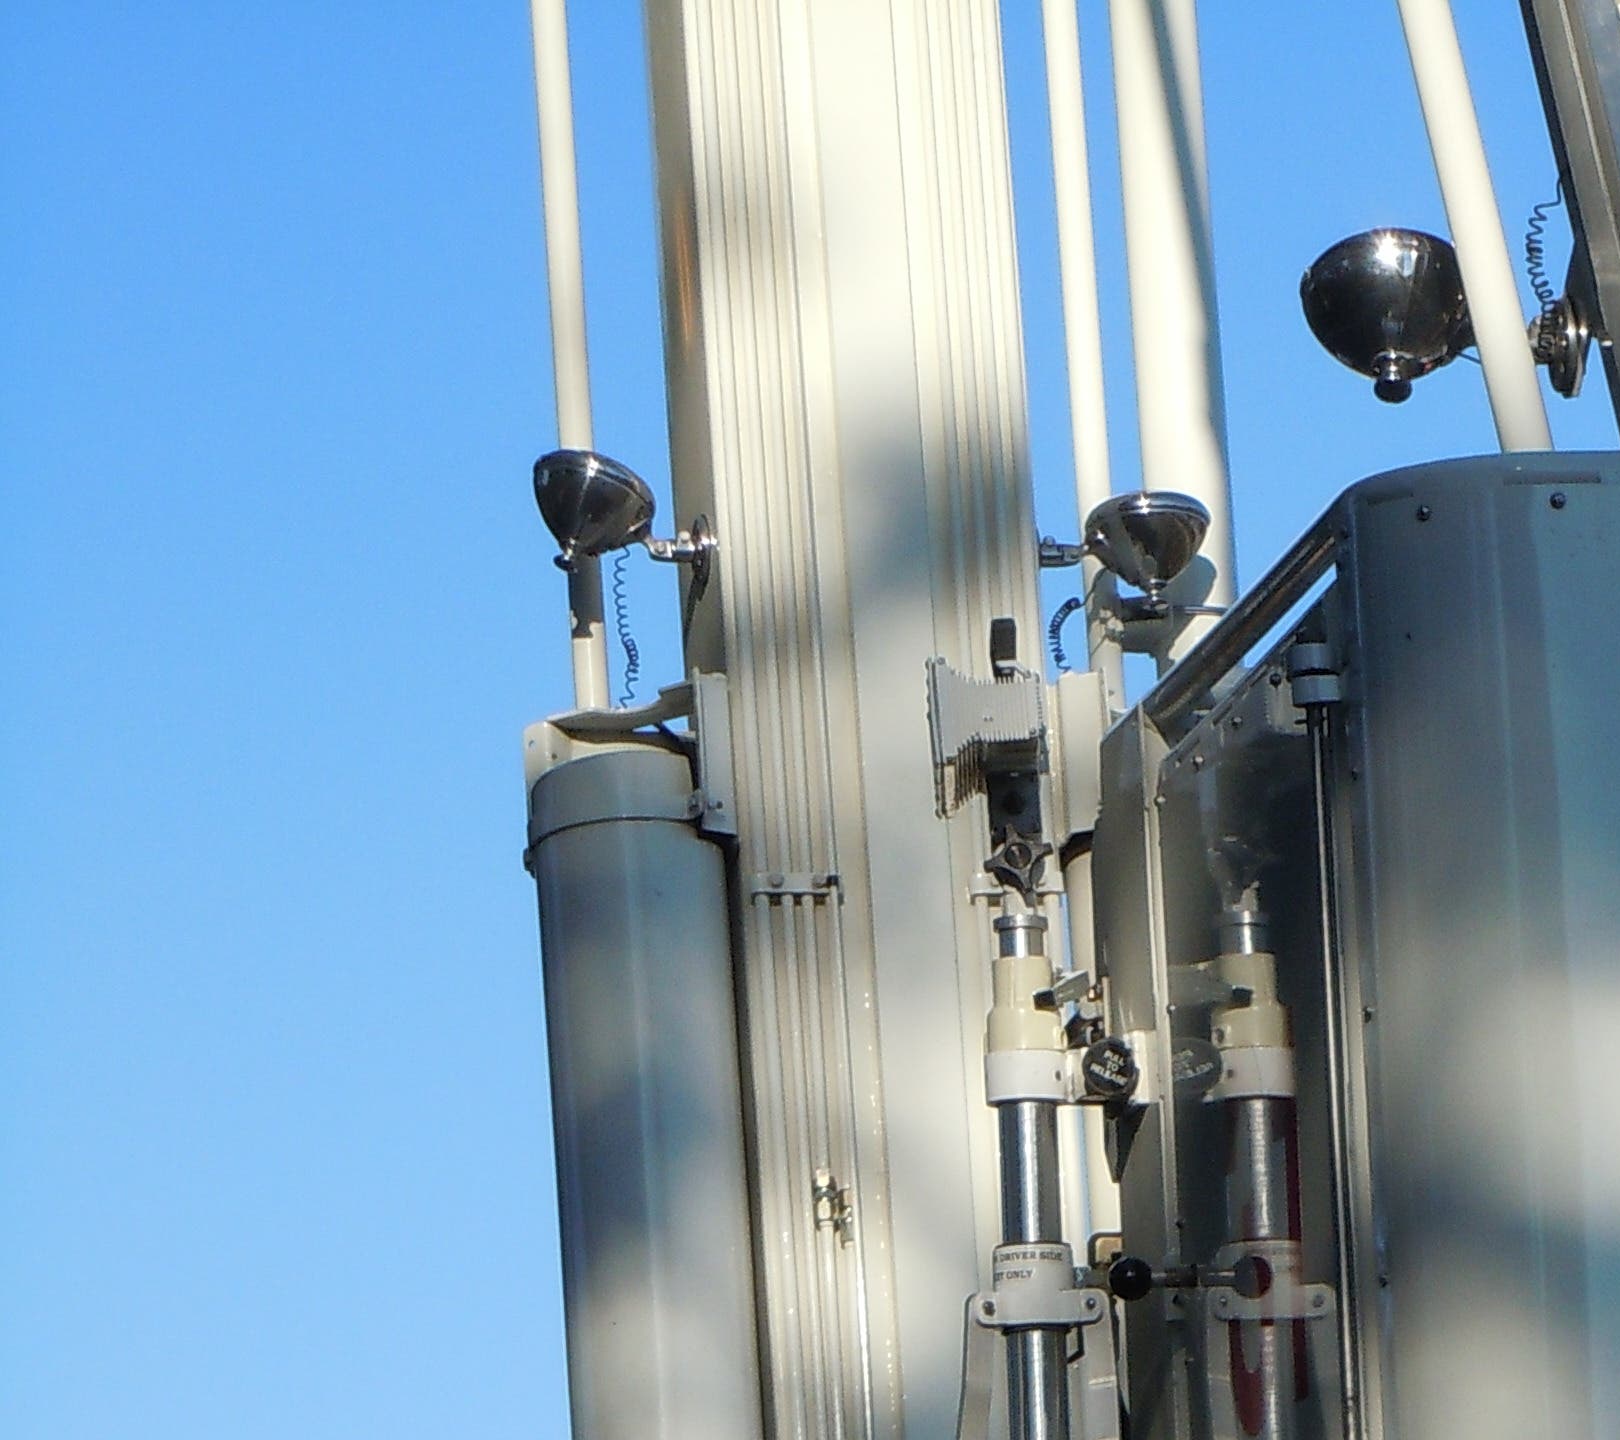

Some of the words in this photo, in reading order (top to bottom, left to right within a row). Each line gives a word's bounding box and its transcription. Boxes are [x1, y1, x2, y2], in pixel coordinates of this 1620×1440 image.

[1107, 1061, 1119, 1072] TO
[1090, 1063, 1127, 1086] RELEASE
[1000, 1251, 1036, 1262] DRIVER
[1040, 1251, 1062, 1261] SIDE
[1006, 1270, 1033, 1280] ONLY
